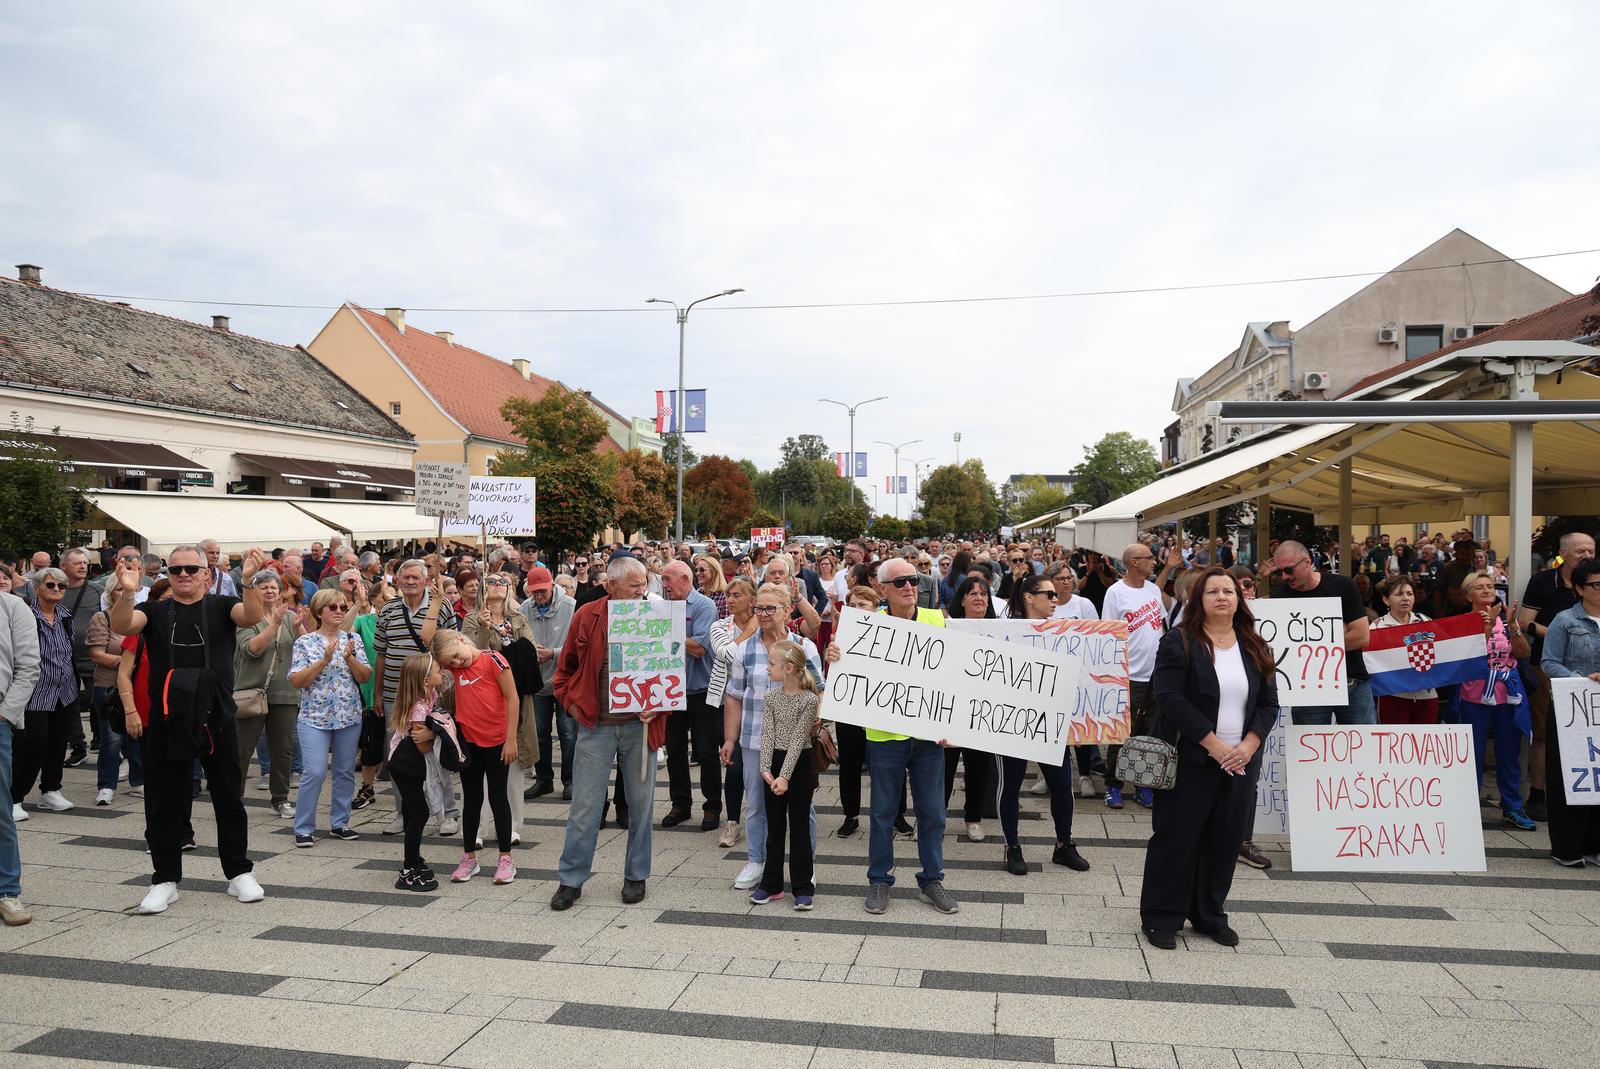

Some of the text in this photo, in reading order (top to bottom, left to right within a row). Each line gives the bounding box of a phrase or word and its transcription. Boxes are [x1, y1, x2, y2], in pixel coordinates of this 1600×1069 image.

[469, 493, 522, 503] DGOVORNOST
[470, 482, 522, 493] NA VLASTITU
[486, 512, 514, 526] NAŠU
[488, 526, 517, 536] DJECU
[1124, 604, 1151, 623] Dosta
[1287, 612, 1342, 643] ČIST
[846, 615, 1059, 697] ŽELIMO SPAVATI
[1270, 644, 1345, 691] K???
[610, 674, 684, 711] SVE?
[833, 671, 955, 724] OTVORENIH
[1564, 688, 1600, 728] NE
[1298, 728, 1469, 769] STOP TROVANJU
[1316, 772, 1442, 812] NAŠIČKOG
